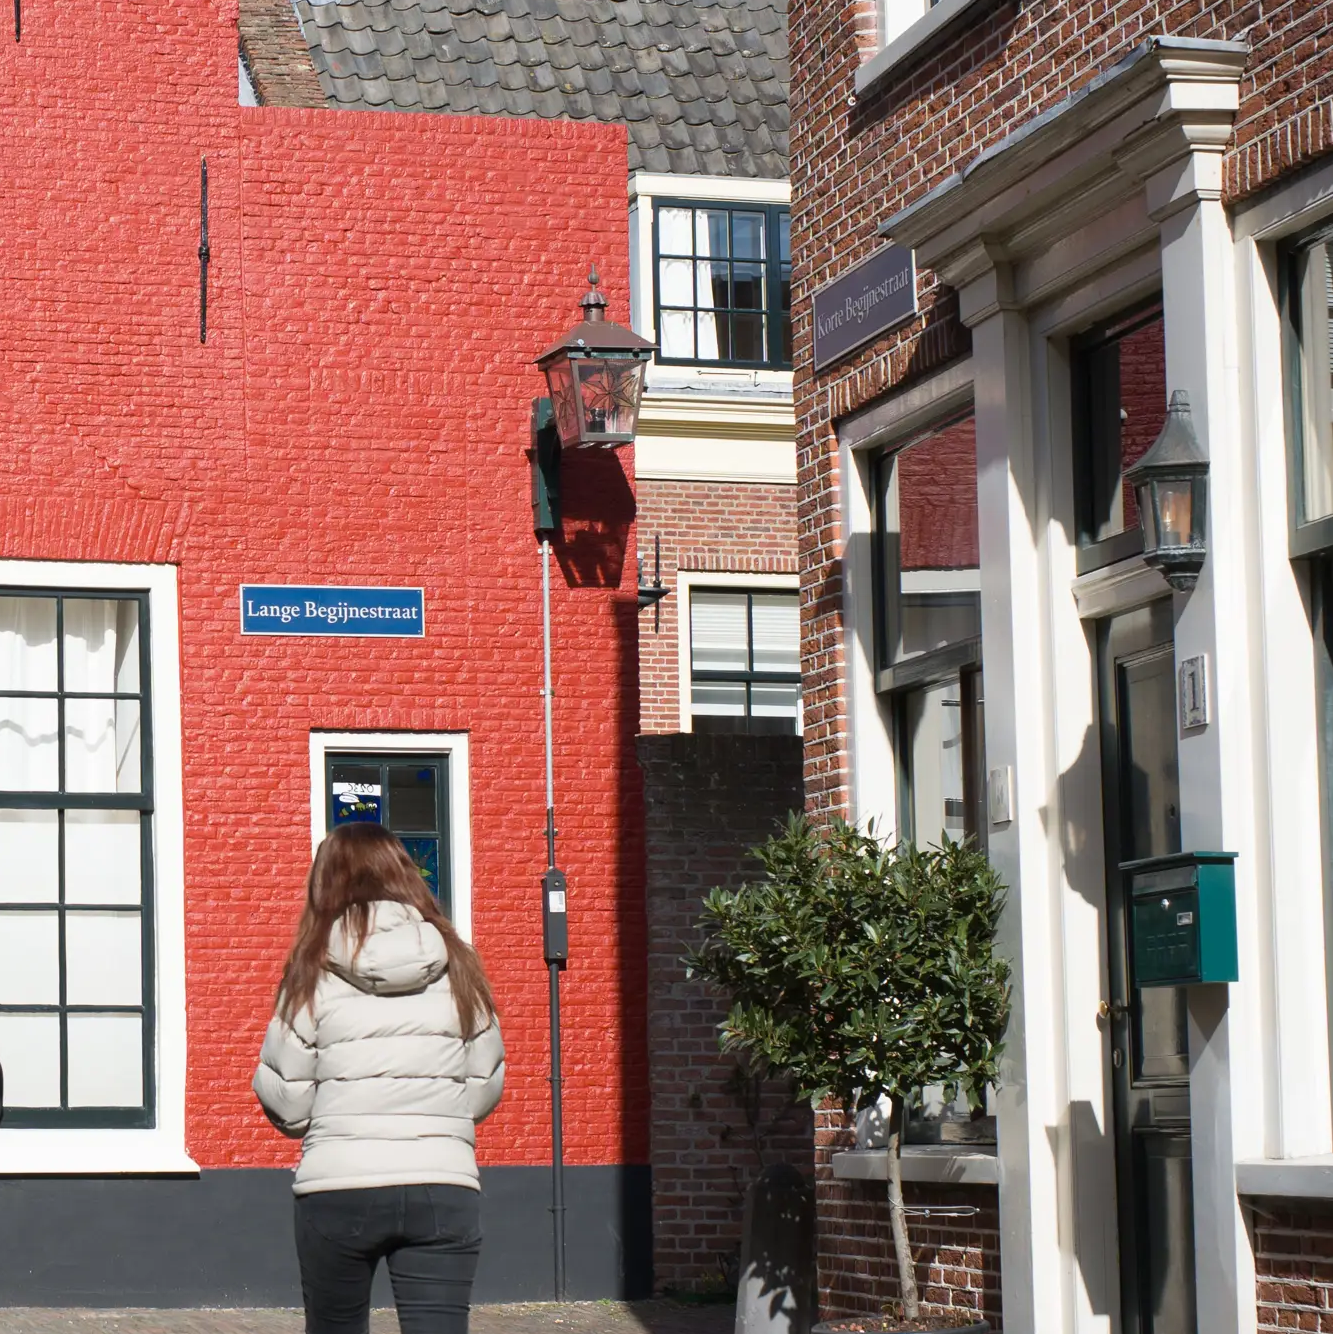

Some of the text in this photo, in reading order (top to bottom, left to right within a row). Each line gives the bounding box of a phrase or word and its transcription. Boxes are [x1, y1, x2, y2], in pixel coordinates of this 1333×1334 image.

[818, 267, 909, 339] Korte Begijnestraat
[247, 600, 418, 624] Lange Begijnestraat
[1188, 671, 1200, 712] 1
